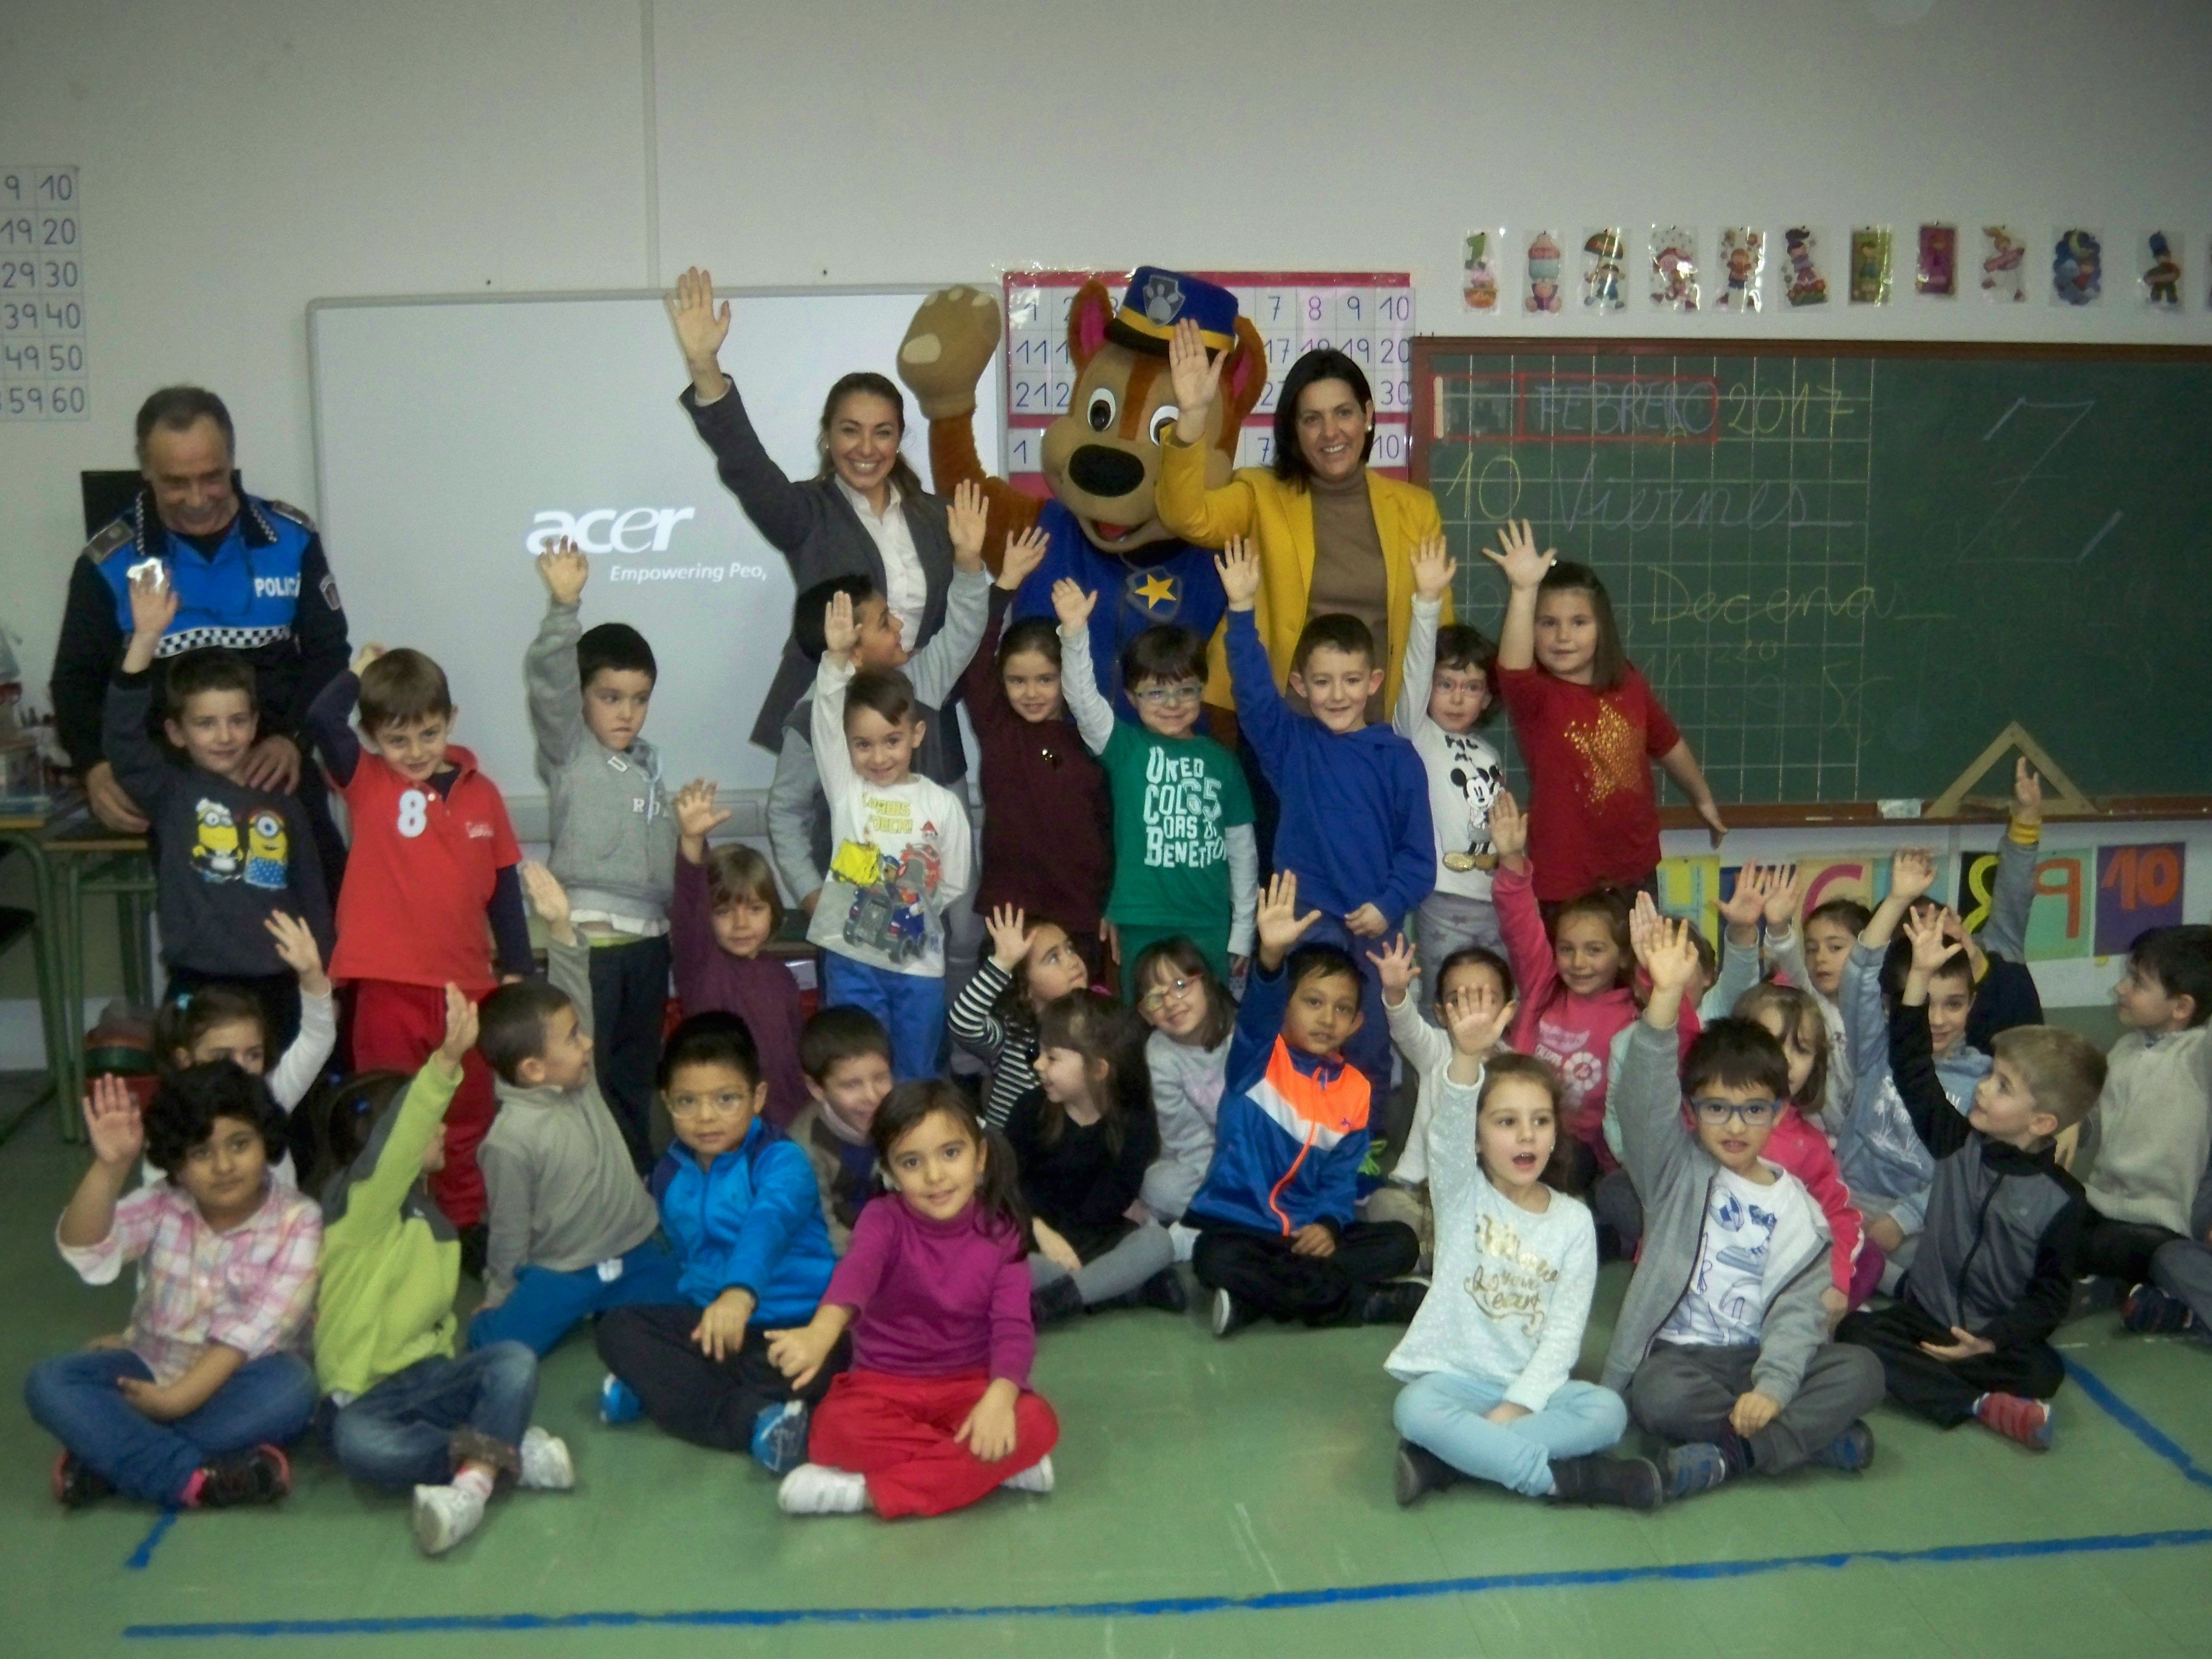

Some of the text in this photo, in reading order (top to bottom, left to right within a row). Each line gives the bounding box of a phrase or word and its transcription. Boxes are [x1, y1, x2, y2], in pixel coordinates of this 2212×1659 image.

[4, 174, 72, 201] 9 10
[0, 218, 76, 245] 19 20
[2, 260, 79, 289] 29 30
[4, 302, 81, 330] 39 40
[1267, 295, 1281, 321] 7
[1308, 295, 1322, 321] 8
[1347, 296, 1360, 321] 9
[1379, 295, 1410, 321] 10
[5, 344, 83, 372] 49 50
[1016, 339, 1047, 364] 11
[1264, 338, 1290, 363] 17
[1339, 338, 1370, 363] 19
[1380, 338, 1410, 364] 20
[9, 387, 85, 414] 59 60
[1015, 382, 1047, 407] 21
[1380, 380, 1410, 406] 30
[1728, 382, 1855, 436] 2017
[1013, 434, 1400, 465] 1 7 10
[1446, 451, 1521, 520] 10
[526, 507, 696, 554] acer
[609, 562, 725, 585] Empowering
[397, 789, 429, 838] 8
[2101, 846, 2181, 911] 10
[2036, 858, 2081, 939] 9
